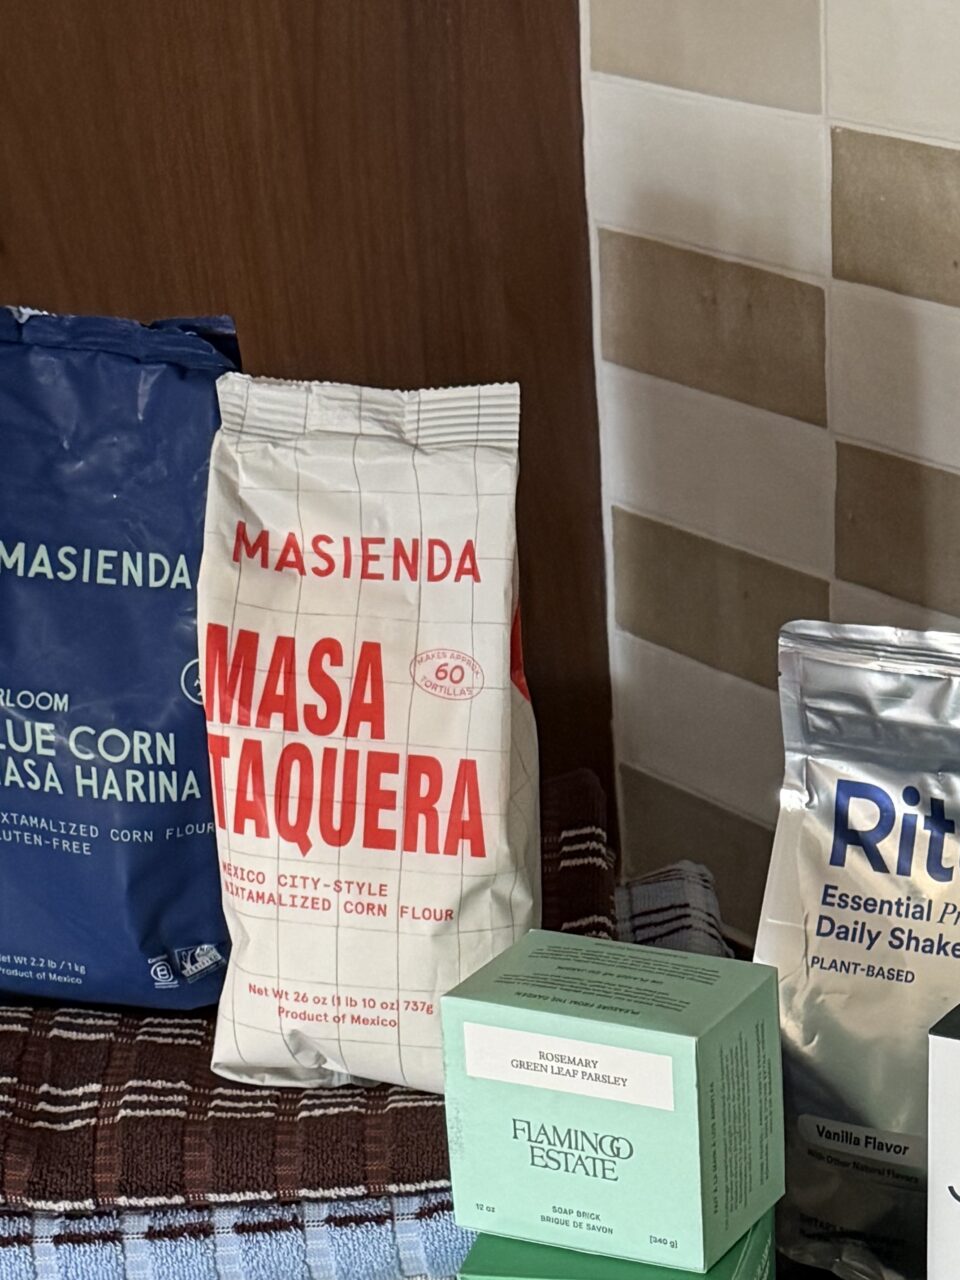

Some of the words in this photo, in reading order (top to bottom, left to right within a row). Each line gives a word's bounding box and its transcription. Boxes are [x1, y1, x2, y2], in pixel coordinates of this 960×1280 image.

[0, 542, 192, 589] MASIENDA
[232, 521, 481, 584] MASIENDA
[205, 623, 386, 740] MASA
[420, 675, 474, 696] TORTILLAS
[435, 663, 464, 684] 60
[0, 719, 56, 756] UE
[68, 726, 175, 765] CORN
[0, 756, 63, 795] ASA
[75, 765, 201, 803] HARINA
[209, 733, 487, 857] TAQUERA
[0, 832, 91, 855] UTEN-FREE
[110, 829, 154, 842] CORN
[165, 822, 215, 841] FLOUR
[223, 861, 266, 884] MEXICO
[277, 874, 388, 897] CITY-STYLE
[224, 881, 331, 912] NIXTAMALIZED
[344, 901, 387, 917] CORN
[400, 905, 454, 922] FLOUR
[821, 884, 933, 923] Essential
[815, 914, 882, 951] Daily
[14, 955, 28, 965] Wt
[810, 956, 915, 985] PLANT-BASED
[36, 972, 46, 980] of
[49, 974, 83, 985] Mexico
[249, 983, 269, 997] Net
[272, 987, 289, 1001] Wt
[293, 991, 309, 1003] 26
[313, 994, 328, 1006] oz
[345, 995, 358, 1009] lb
[362, 997, 376, 1010] 10
[404, 1000, 434, 1015] 737g
[278, 1006, 329, 1024] Product
[333, 1012, 346, 1024] of
[351, 1013, 397, 1028] Mexico
[511, 1058, 548, 1076] GREEN
[550, 1065, 579, 1079] LEAF
[581, 1070, 629, 1088] PARSLEY
[538, 1050, 599, 1070] ROSEMARY
[512, 1118, 634, 1160] FLAMINGO
[816, 1124, 860, 1146] Vanilla
[864, 1134, 910, 1156] Flavor
[529, 1146, 619, 1182] ESTATE
[475, 1203, 484, 1211] 12
[486, 1205, 496, 1213] oz
[551, 1205, 574, 1216] SOAP
[576, 1209, 601, 1222] BRICK
[540, 1214, 570, 1227] BRIQUE
[572, 1220, 584, 1229] DE
[586, 1222, 614, 1235] SAVON
